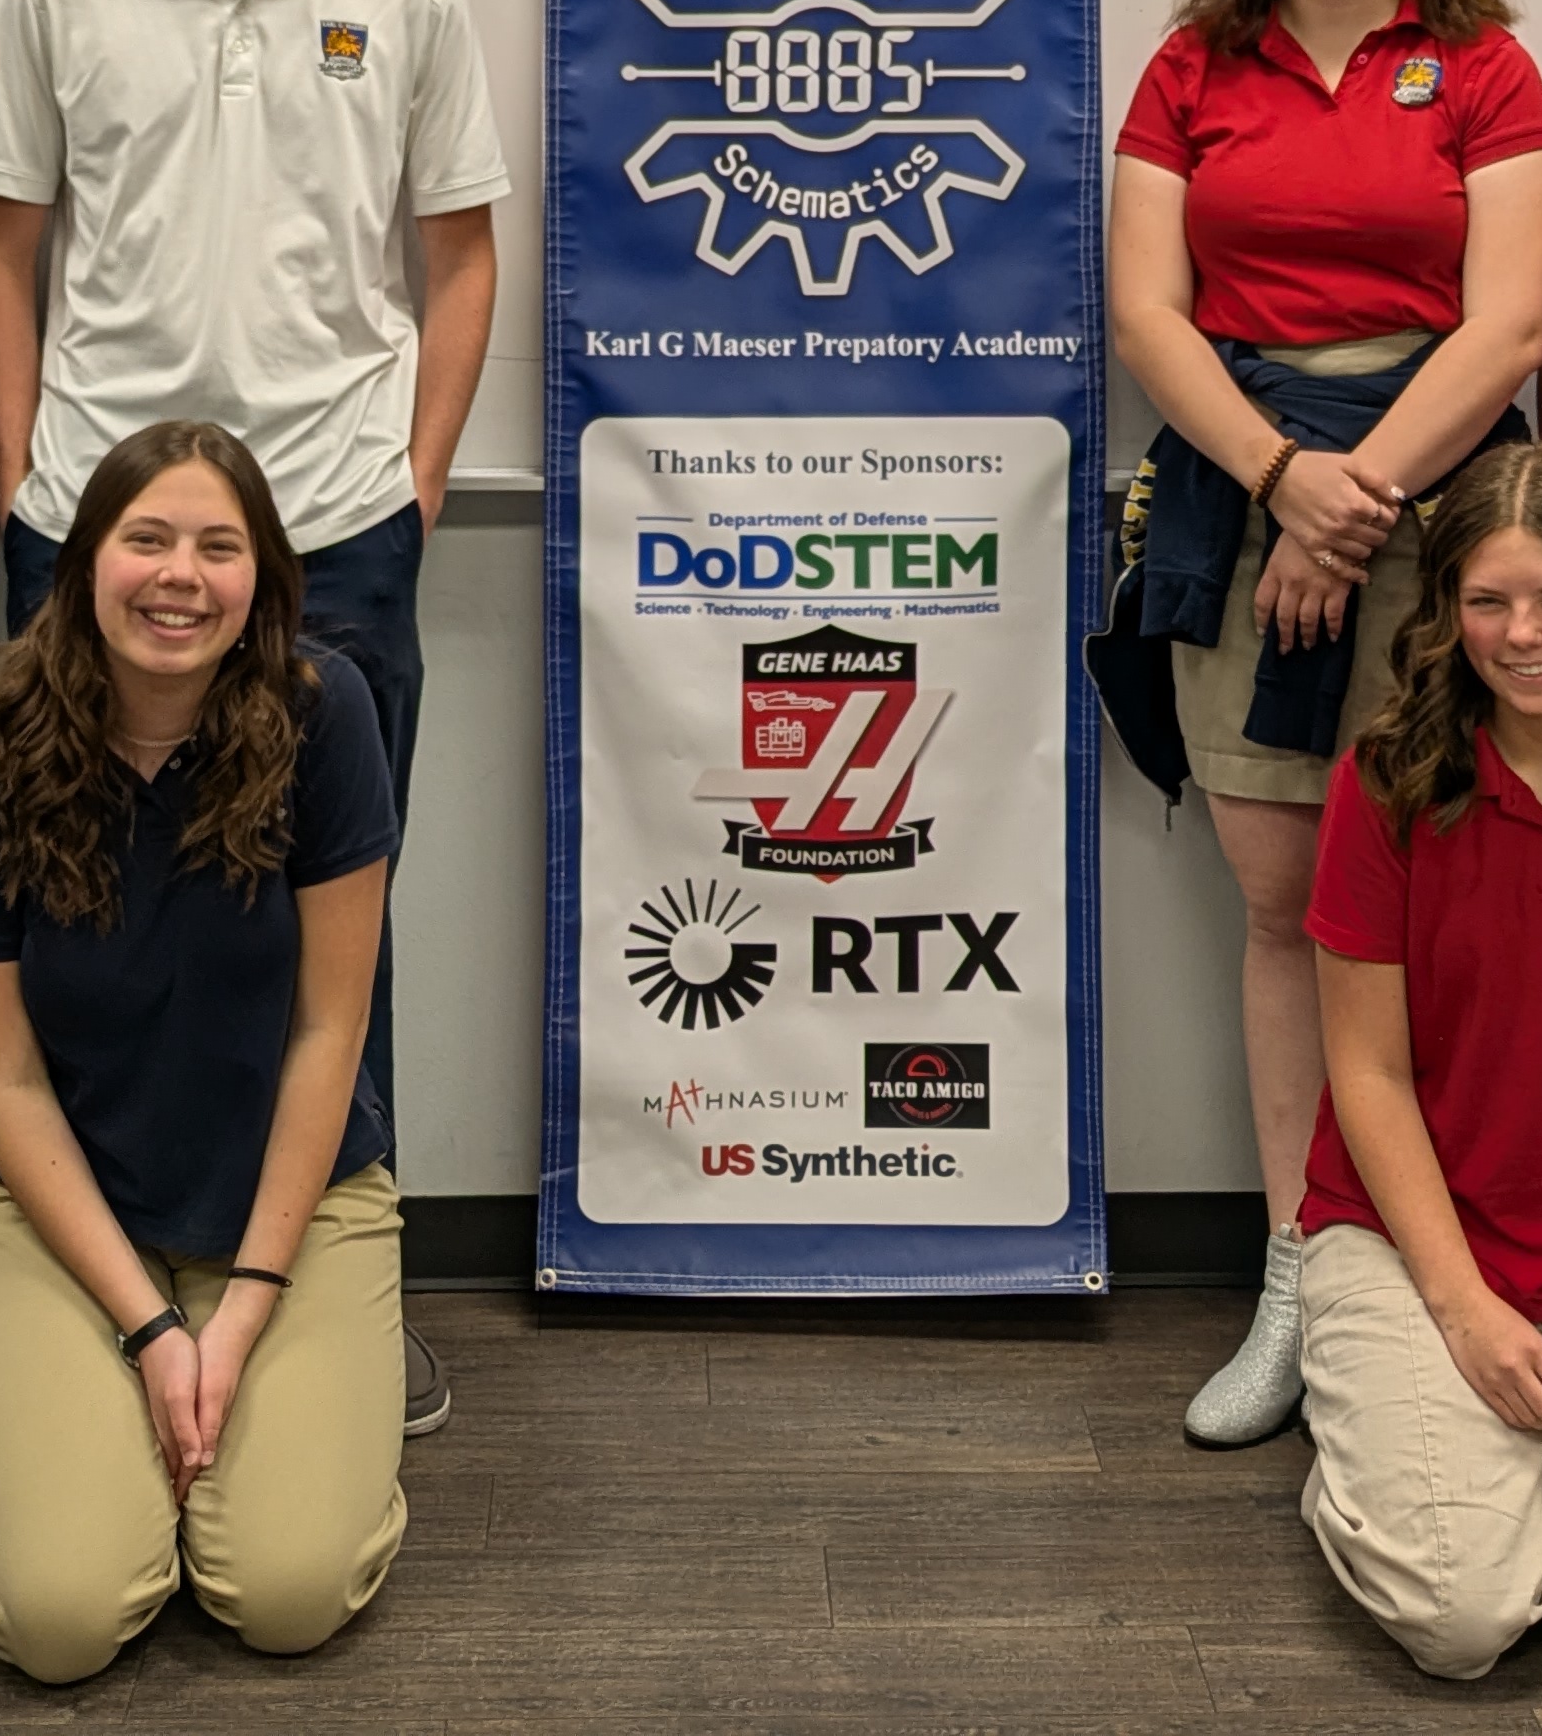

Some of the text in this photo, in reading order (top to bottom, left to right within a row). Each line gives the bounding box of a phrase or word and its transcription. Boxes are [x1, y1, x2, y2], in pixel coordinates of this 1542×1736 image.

[724, 29, 923, 114] 8885
[713, 143, 939, 220] Schematics
[585, 331, 1081, 364] Karl G Maeser Prepatory Academy
[648, 450, 1003, 480] Thanks to our Sponsors:
[708, 512, 927, 530] Department of Defense
[637, 532, 997, 590] DoDSTEM
[635, 600, 1000, 620] Science Technology Engineering Mathematics
[758, 651, 902, 673] GENE HAAS
[759, 846, 895, 866] FOUNDATION
[811, 911, 1021, 994] RTX
[869, 1081, 985, 1099] TACO AMIGO
[701, 1143, 964, 1183] US Synthetic
